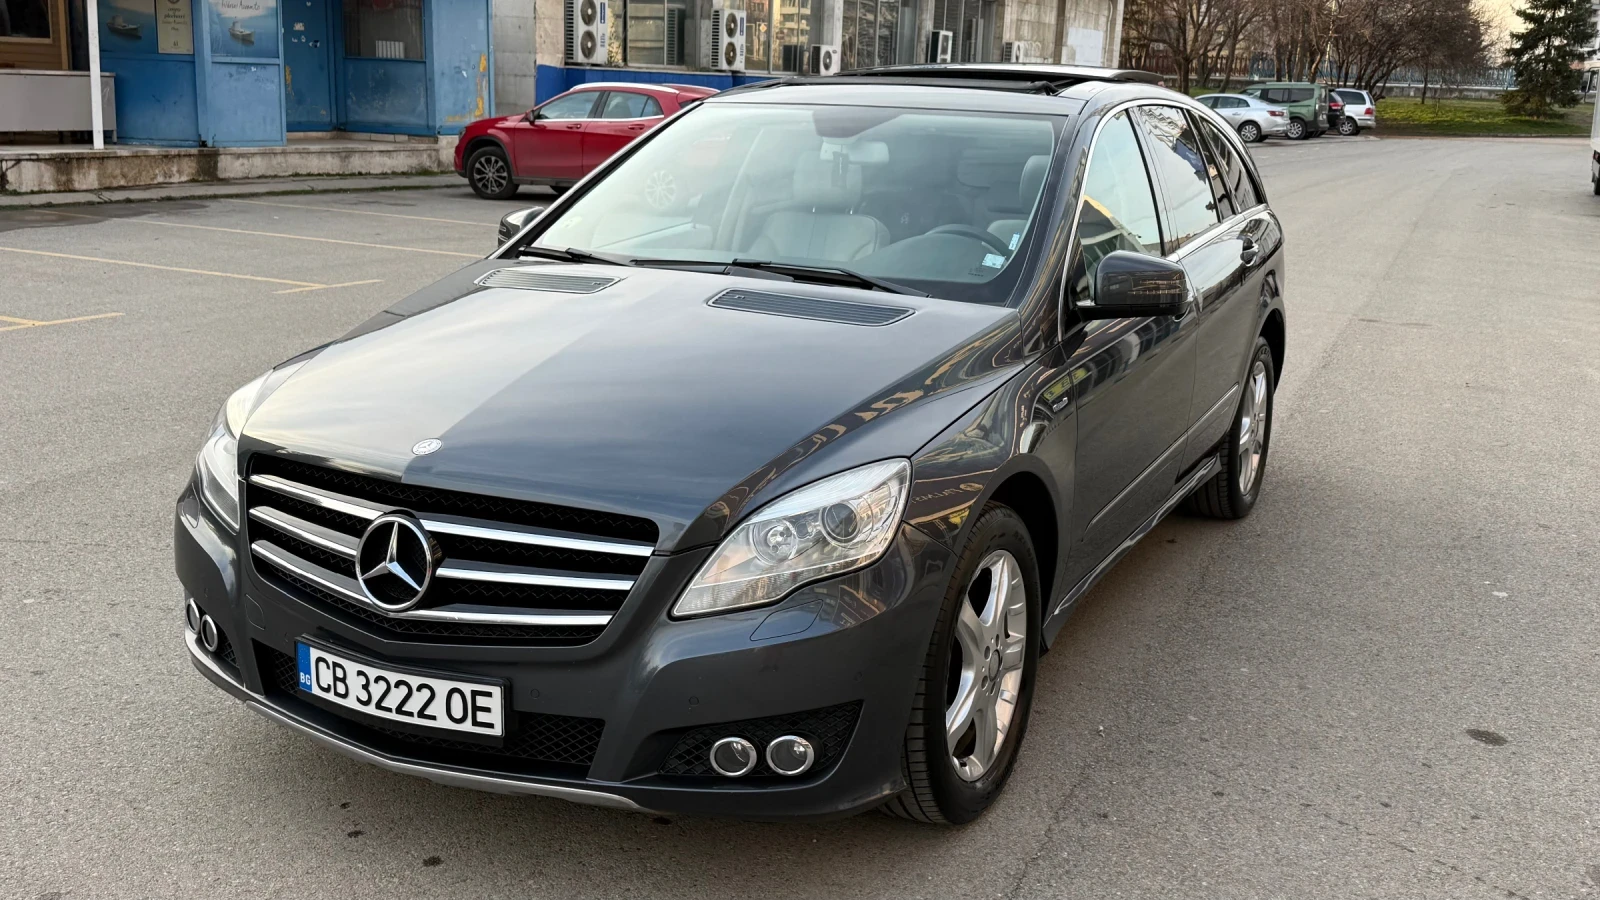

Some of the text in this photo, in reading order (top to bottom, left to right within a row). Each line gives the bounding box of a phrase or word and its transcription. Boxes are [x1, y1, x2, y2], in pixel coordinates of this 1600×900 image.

[300, 671, 311, 686] BG
[315, 656, 495, 729] CB 3222 OE
